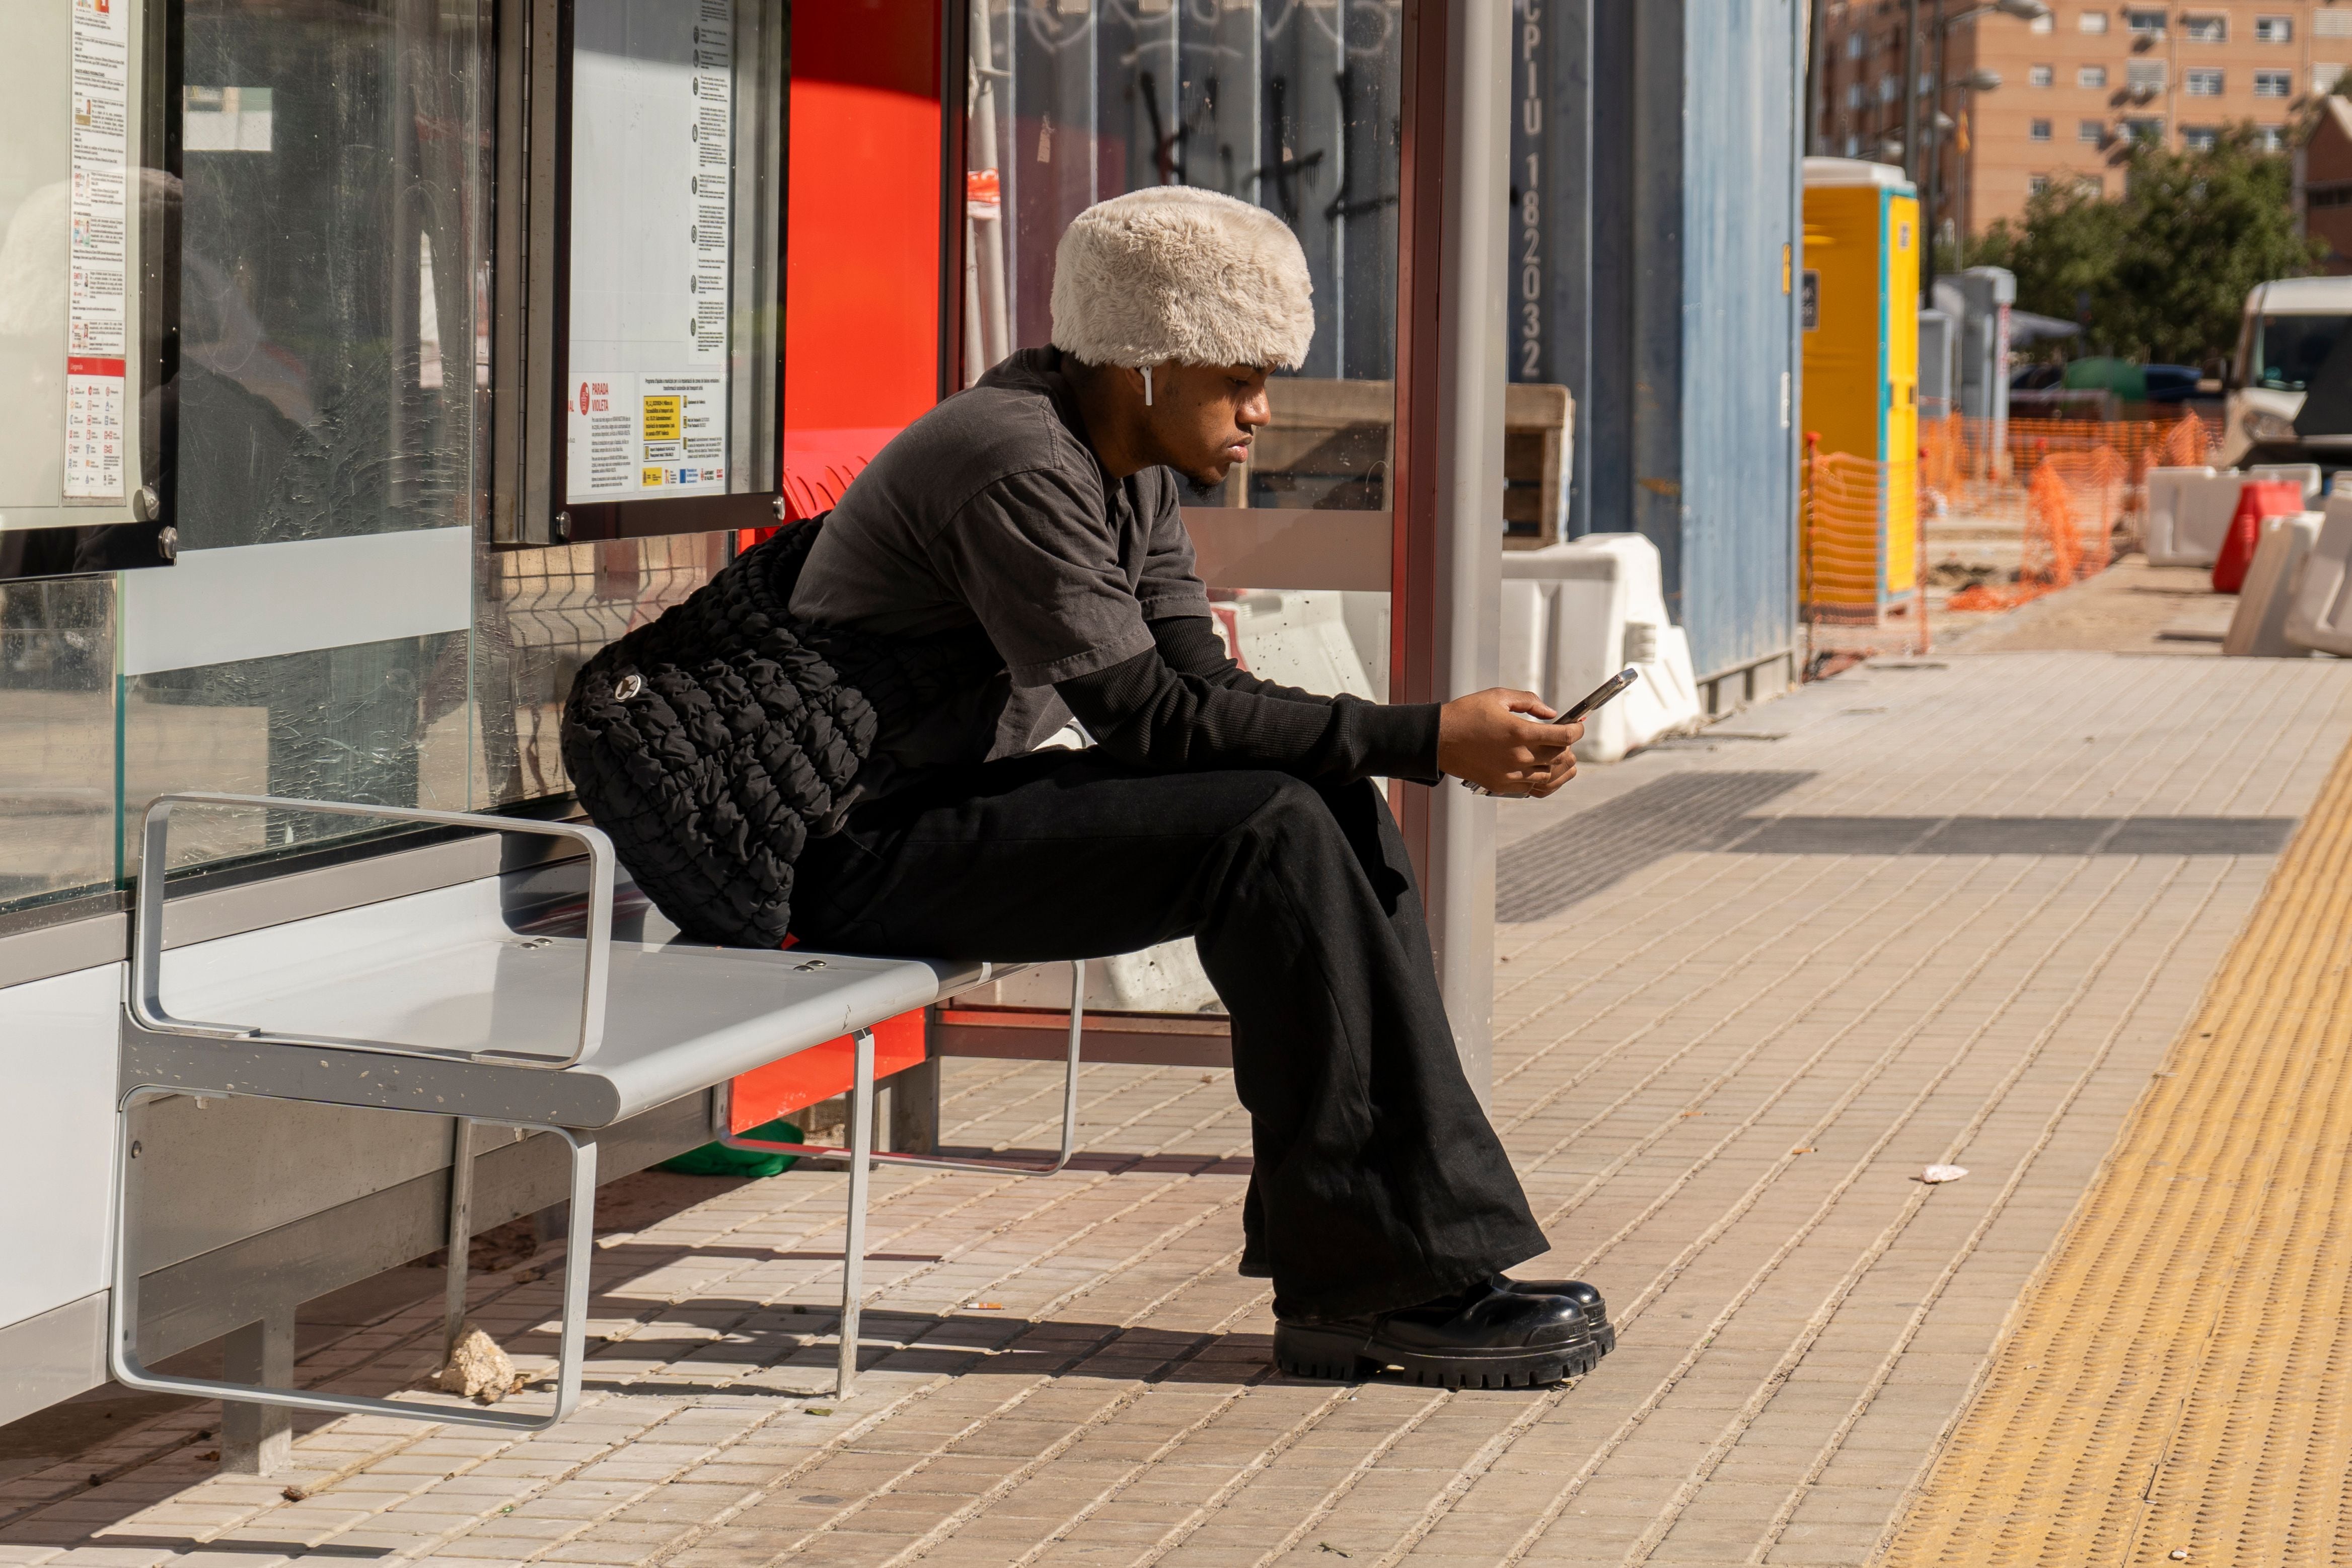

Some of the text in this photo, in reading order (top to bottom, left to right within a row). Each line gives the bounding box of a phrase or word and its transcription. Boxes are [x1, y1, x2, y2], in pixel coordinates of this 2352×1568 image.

[1522, 152, 1541, 377] 182032
[592, 383, 608, 395] PARADA
[592, 399, 608, 411] VIOLETA
